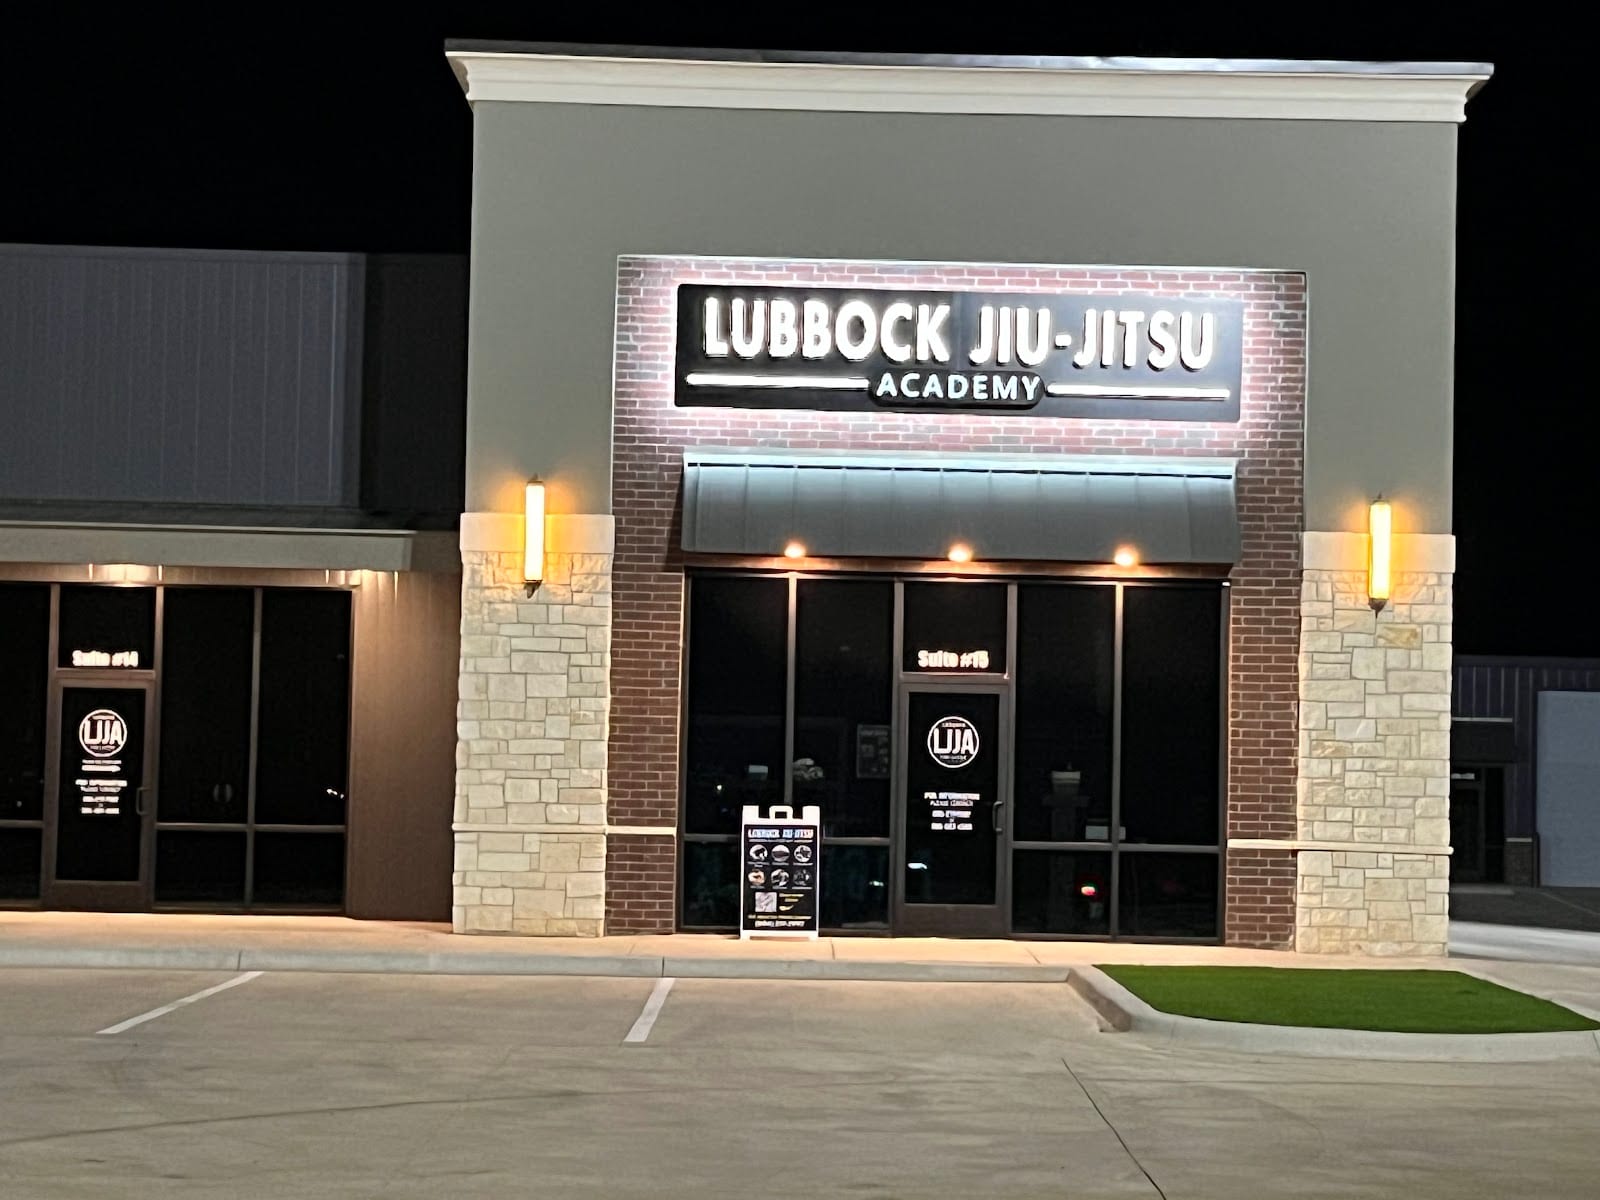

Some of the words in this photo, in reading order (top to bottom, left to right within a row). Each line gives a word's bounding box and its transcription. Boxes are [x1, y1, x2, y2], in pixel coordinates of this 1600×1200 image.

[704, 297, 951, 363] LUBBOCK
[968, 305, 1214, 371] JIU-JITSU
[876, 372, 1041, 401] ACADEMY
[917, 650, 959, 668] Suite
